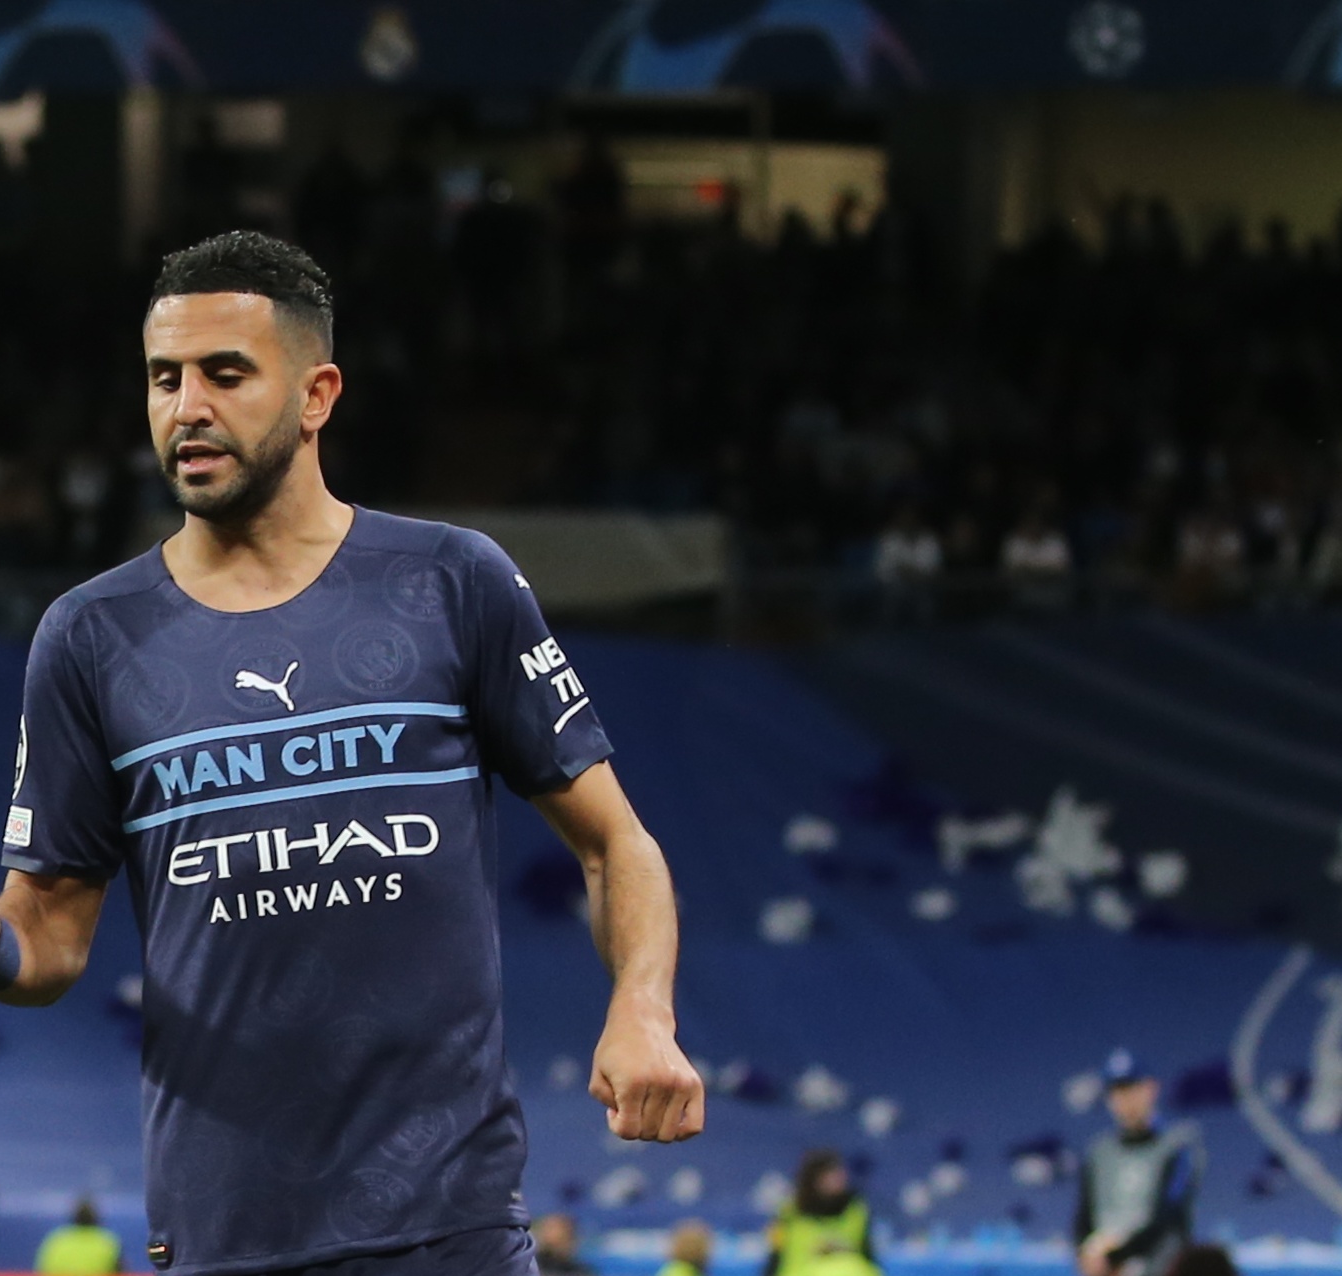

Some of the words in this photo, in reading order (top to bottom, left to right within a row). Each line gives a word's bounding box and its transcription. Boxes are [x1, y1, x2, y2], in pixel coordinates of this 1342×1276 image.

[152, 742, 266, 800] MAN
[281, 723, 406, 776] CITY
[167, 814, 440, 886] ETIHAD
[209, 873, 403, 924] AIRWAYS
